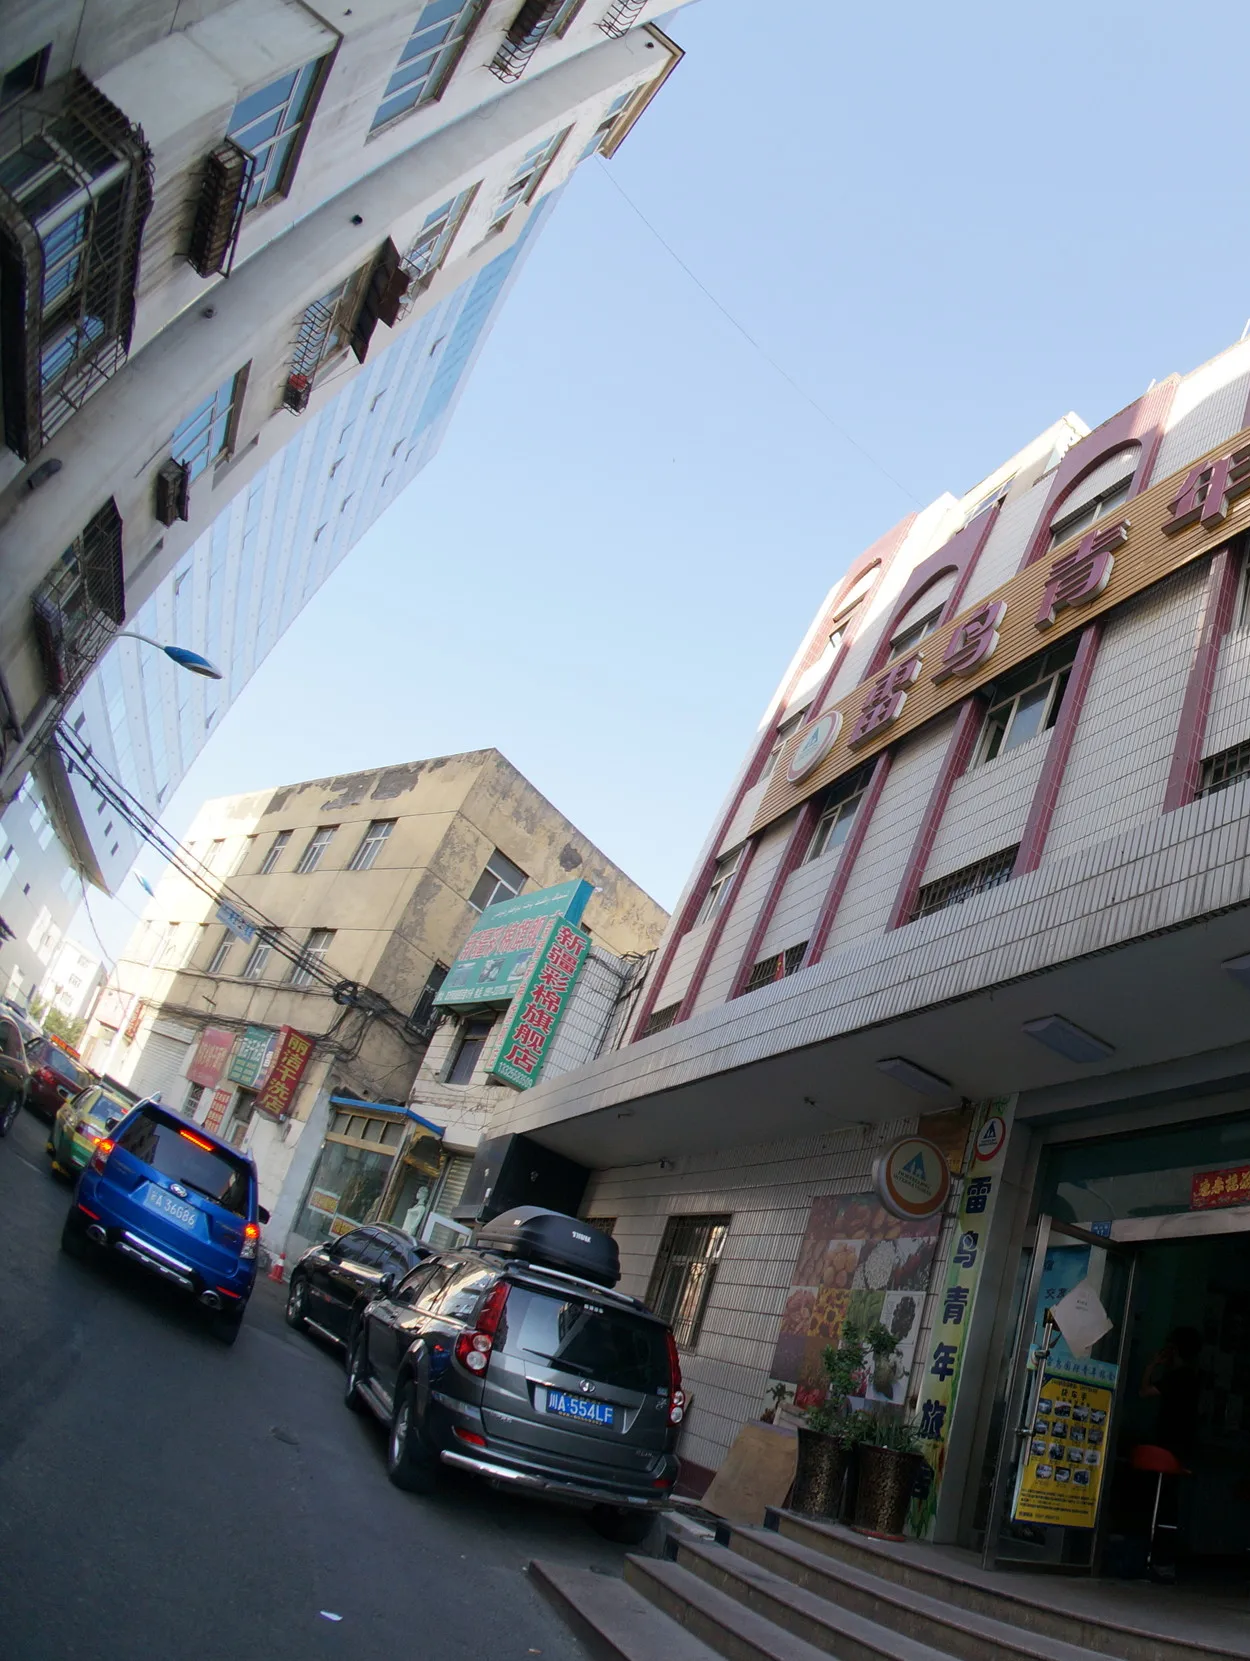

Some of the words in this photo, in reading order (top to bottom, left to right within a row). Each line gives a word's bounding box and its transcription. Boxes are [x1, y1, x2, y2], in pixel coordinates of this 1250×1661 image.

[457, 910, 564, 961] 新疆彩棉旗舰
[504, 925, 588, 1075] 新疆彩棉旗舰店
[261, 1032, 312, 1115] 丽洁干洗店
